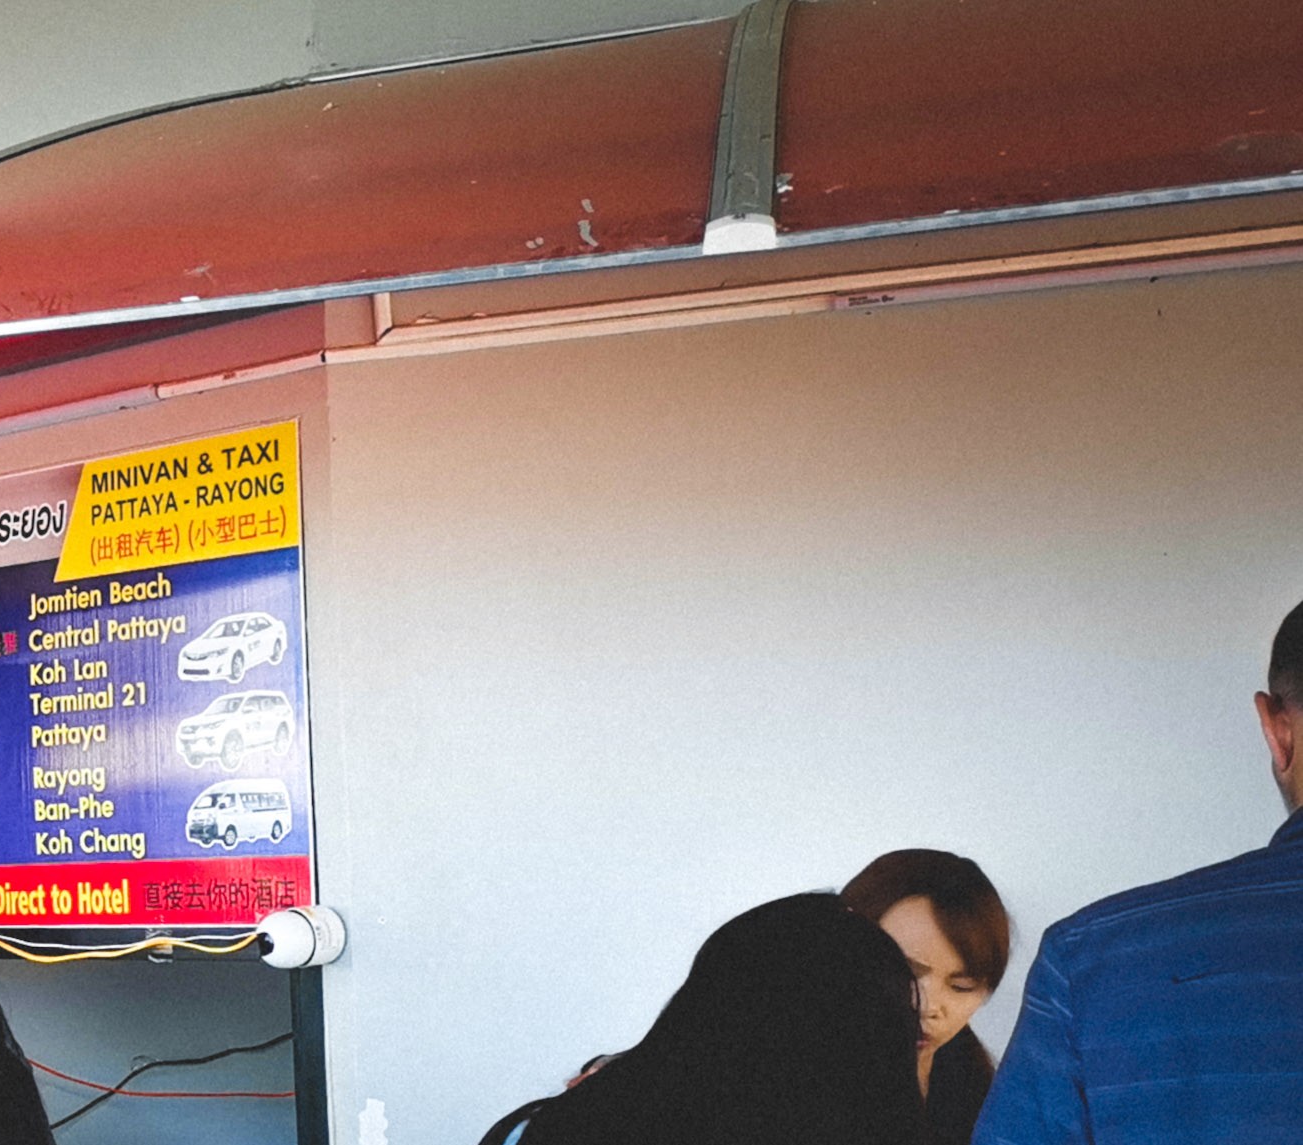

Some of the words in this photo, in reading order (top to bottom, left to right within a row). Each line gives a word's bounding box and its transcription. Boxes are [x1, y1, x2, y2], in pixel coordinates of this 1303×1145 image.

[92, 457, 188, 494] MINIVAN
[197, 452, 213, 475] &
[221, 439, 279, 469] TAXI
[92, 491, 178, 526] PATTAYA
[196, 472, 285, 508] RAYONG
[28, 585, 101, 620] Jomtien
[109, 572, 171, 605] Beach
[29, 625, 99, 651] Central
[108, 615, 186, 643] Pattaya
[30, 663, 66, 686] Koh
[74, 658, 107, 681] Lan
[29, 682, 113, 716] Terminal
[122, 682, 146, 706] 21
[31, 723, 106, 750] Pattaya
[33, 766, 106, 795] Rayong
[34, 794, 114, 822] Ban-Phe
[35, 832, 72, 855] Koh
[79, 828, 145, 859] Chang
[50, 886, 71, 915] to
[77, 879, 130, 915] Hotel
